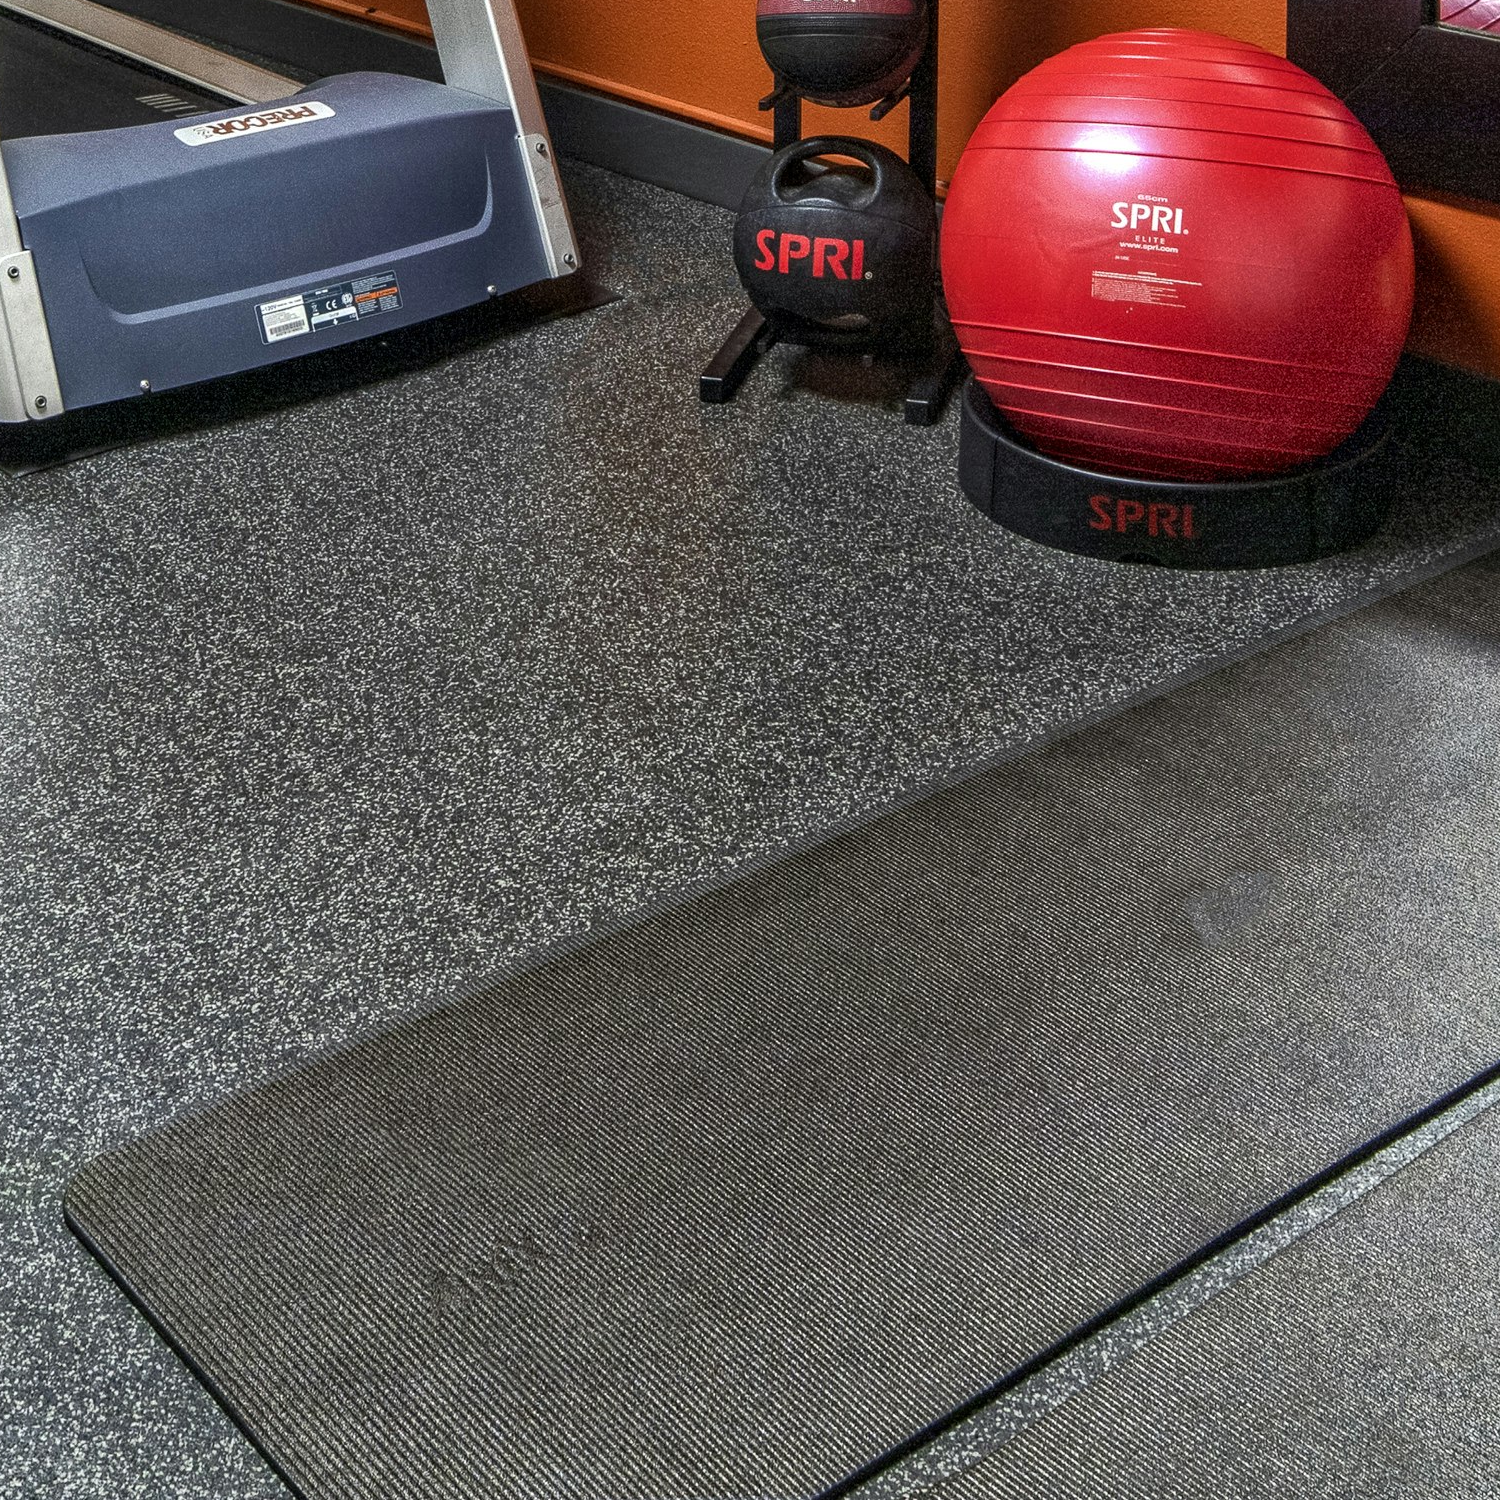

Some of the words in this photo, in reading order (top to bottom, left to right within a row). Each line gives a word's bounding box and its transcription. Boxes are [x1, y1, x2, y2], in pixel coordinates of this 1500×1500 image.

[206, 105, 318, 135] PRECOR
[1110, 201, 1183, 235] SPRI
[754, 229, 864, 280] SPRI
[1119, 241, 1179, 253] www.spri.com
[1135, 235, 1166, 245] ELITE
[1088, 494, 1195, 539] SPRI
